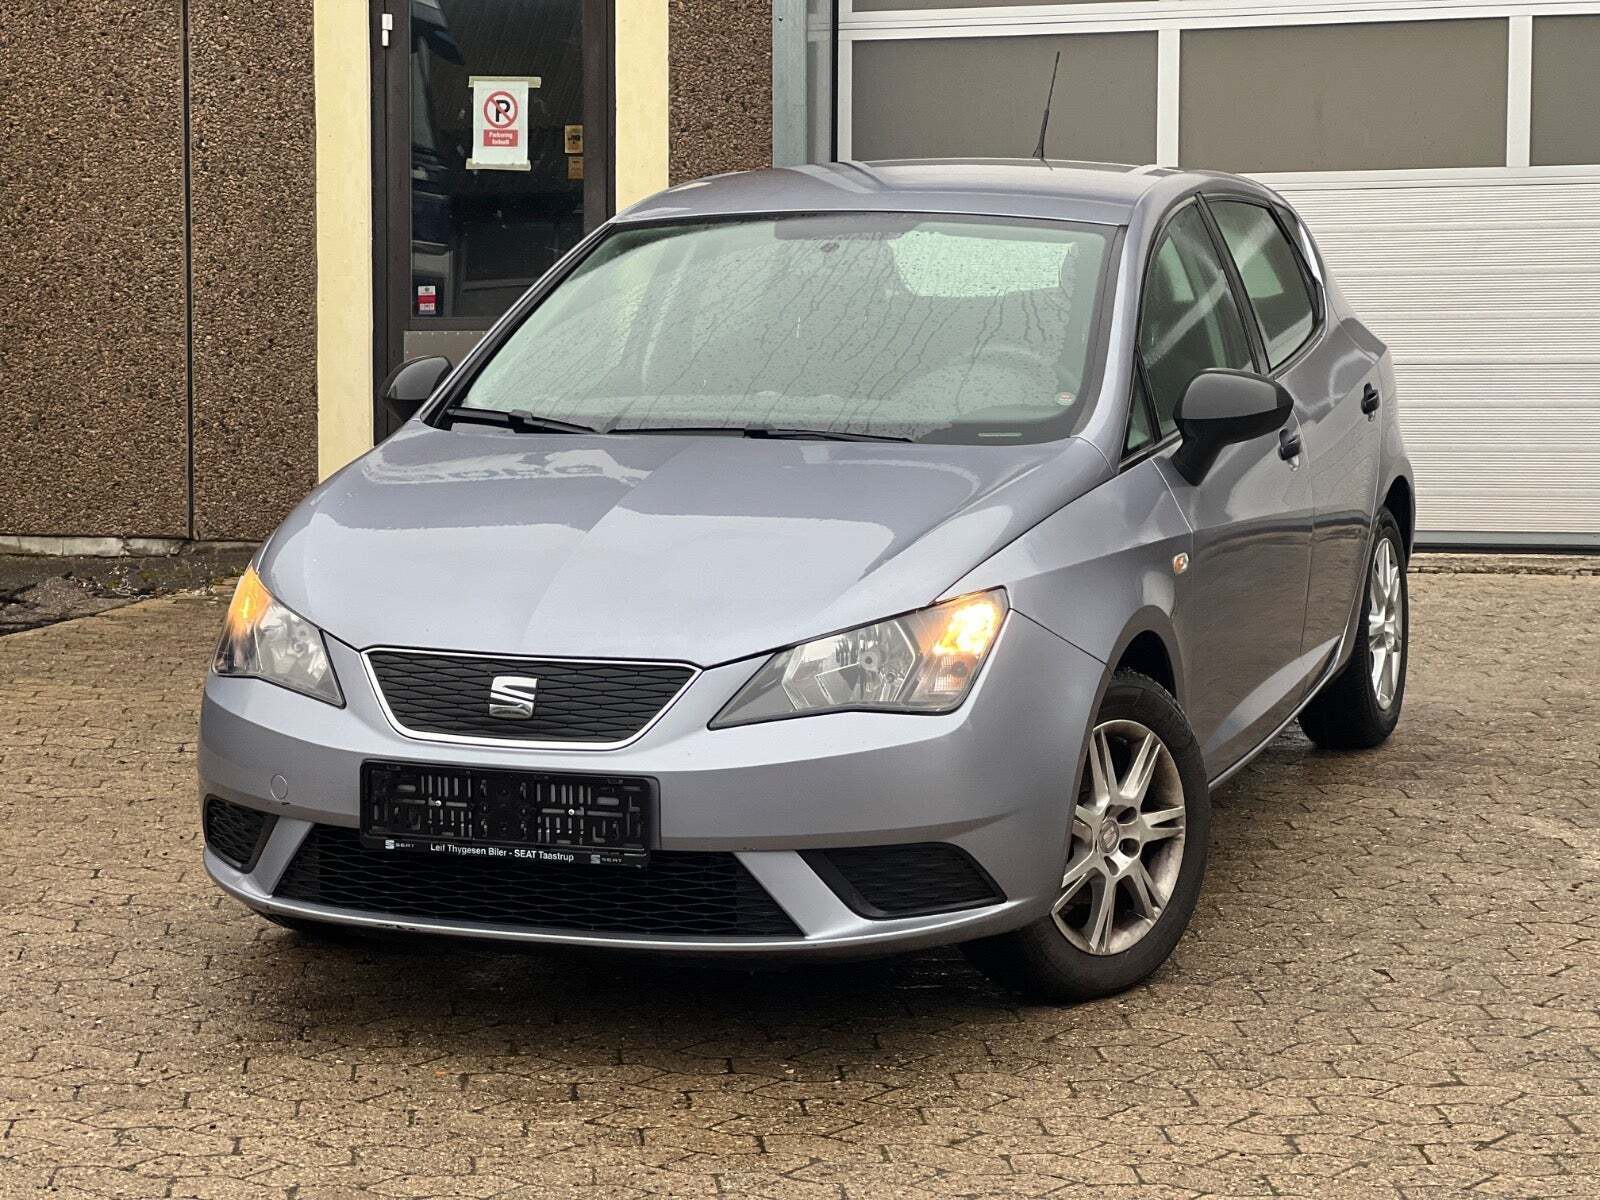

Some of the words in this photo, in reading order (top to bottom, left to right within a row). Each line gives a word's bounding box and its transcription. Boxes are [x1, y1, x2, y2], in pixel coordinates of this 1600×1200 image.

[495, 99, 511, 122] P
[430, 843, 445, 852] Leif
[447, 844, 486, 855] Thygesen
[488, 848, 507, 856] Biler
[514, 849, 536, 859] SEAT
[538, 851, 574, 863] Taastrup
